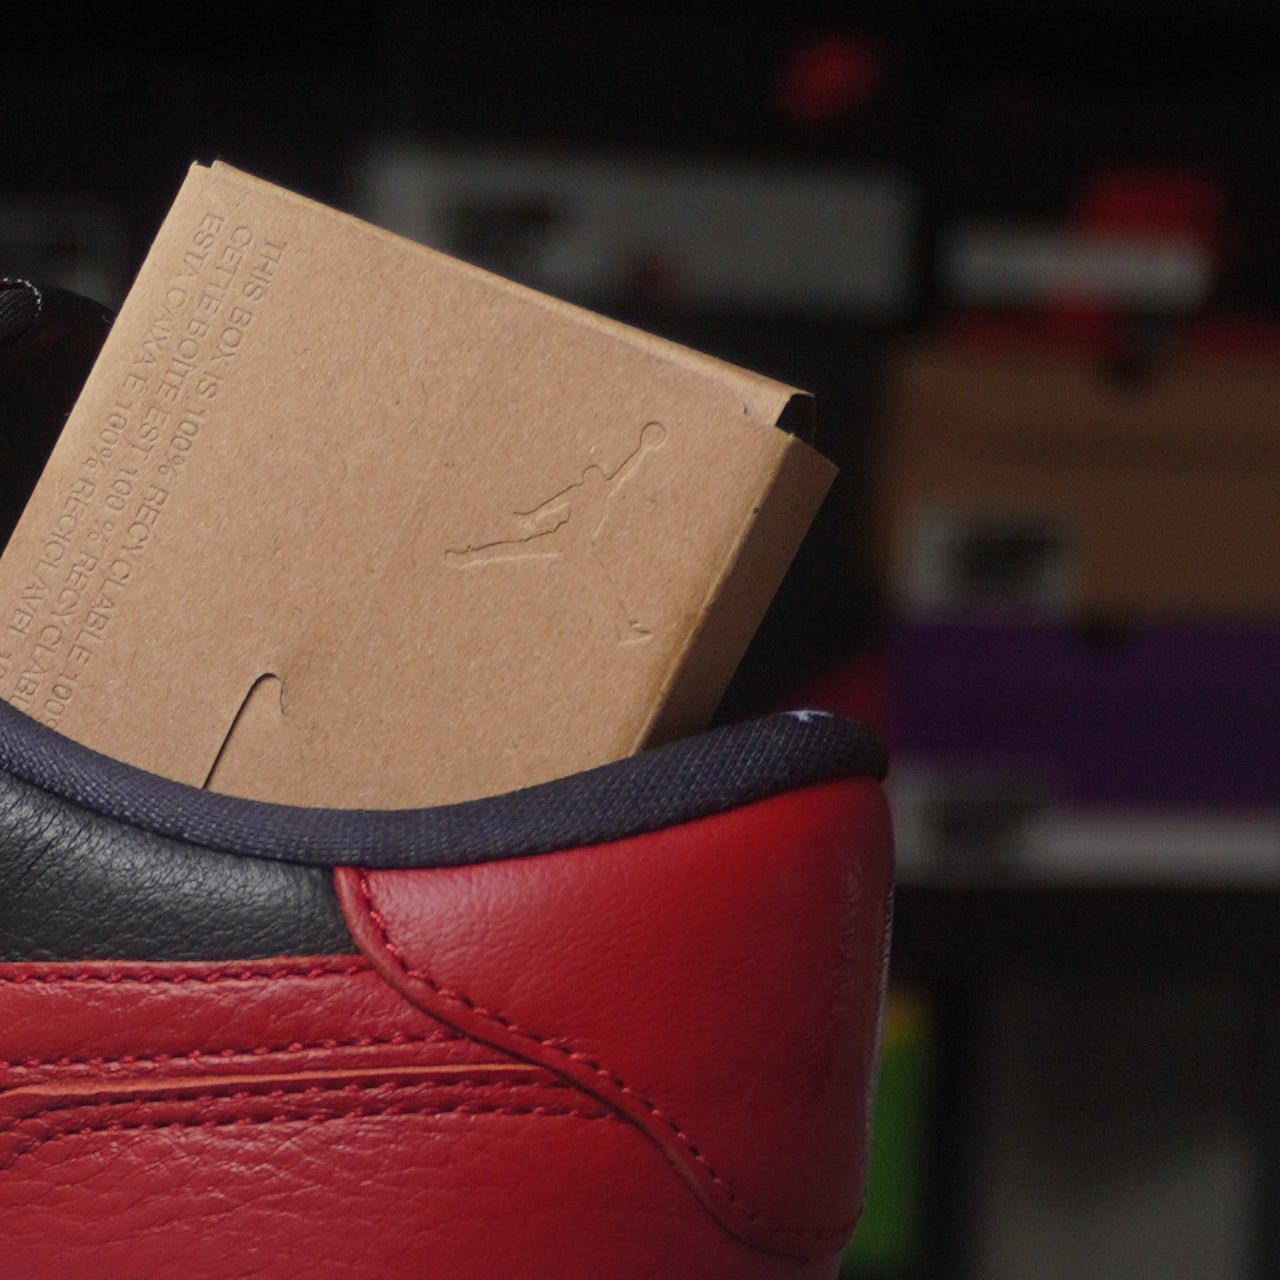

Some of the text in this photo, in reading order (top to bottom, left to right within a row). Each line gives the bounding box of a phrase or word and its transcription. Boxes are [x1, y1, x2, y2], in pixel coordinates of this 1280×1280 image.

[175, 210, 225, 284] ESTA
[194, 222, 256, 318] CETTE
[240, 233, 290, 303] THIS
[131, 283, 190, 373] CAIXA
[208, 304, 255, 369] BOX
[193, 369, 223, 402] IS
[82, 394, 136, 474] 100%
[125, 404, 169, 462] EST
[155, 402, 208, 481] 100%
[101, 461, 141, 513] 100
[64, 482, 170, 667] RECYCLABLE
[5, 549, 100, 712] RECYCLABL
